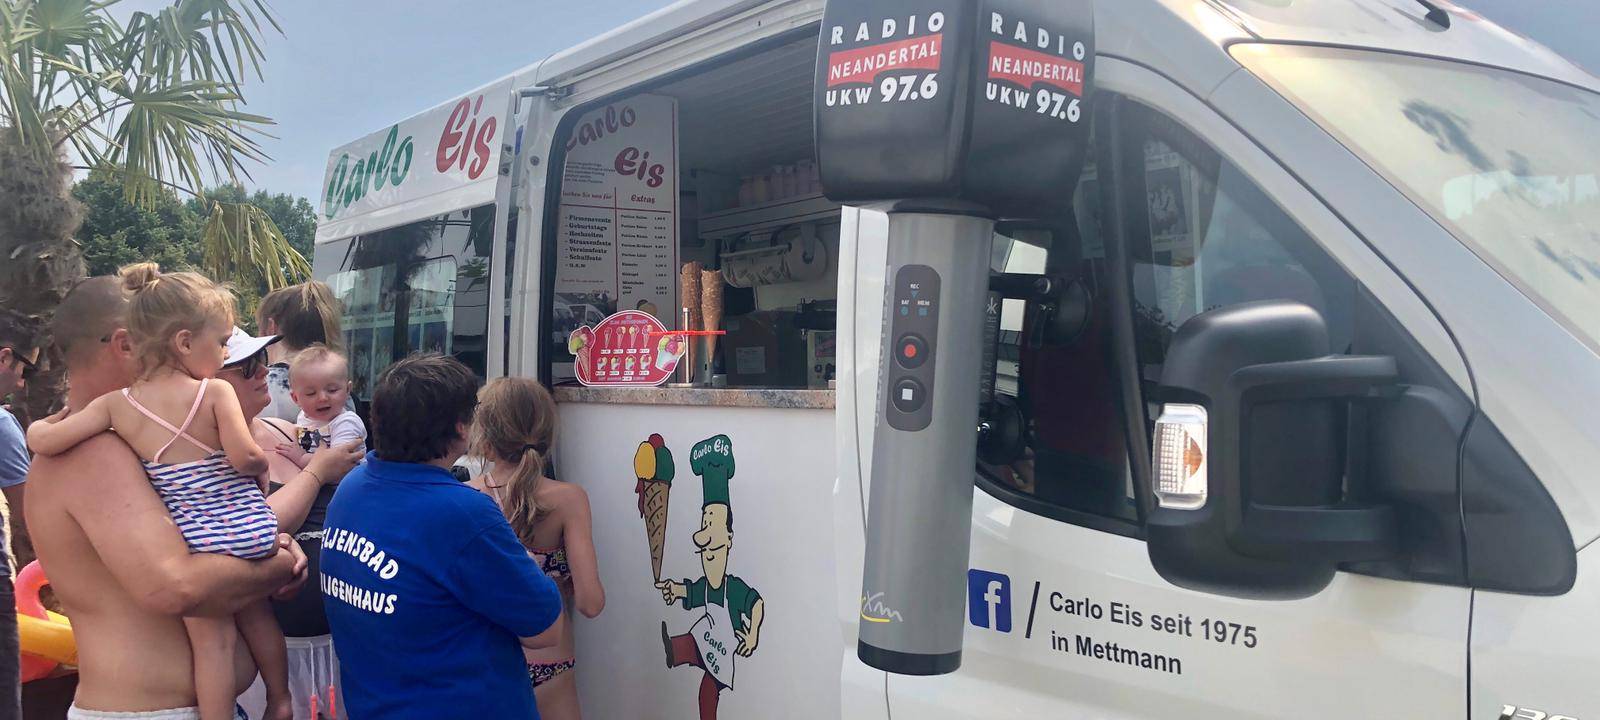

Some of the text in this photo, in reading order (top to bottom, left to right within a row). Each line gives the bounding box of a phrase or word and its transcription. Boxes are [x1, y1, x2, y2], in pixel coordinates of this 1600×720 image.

[830, 11, 945, 45] RADIO
[991, 12, 1085, 61] RADIO
[830, 40, 938, 80] NEANDERTAL
[991, 56, 1081, 83] NEANDERTAL
[825, 73, 938, 107] UKW 97.6
[986, 82, 1081, 123] UKW 97.6
[325, 94, 497, 220] Carlo Eis
[614, 146, 665, 188] Eis
[693, 438, 729, 460] Carlo Eis
[1049, 591, 1258, 649] Carlo Eis seit 1975
[703, 631, 727, 656] Carlo
[706, 652, 720, 674] Eis
[1051, 630, 1182, 675] in Mettmann
